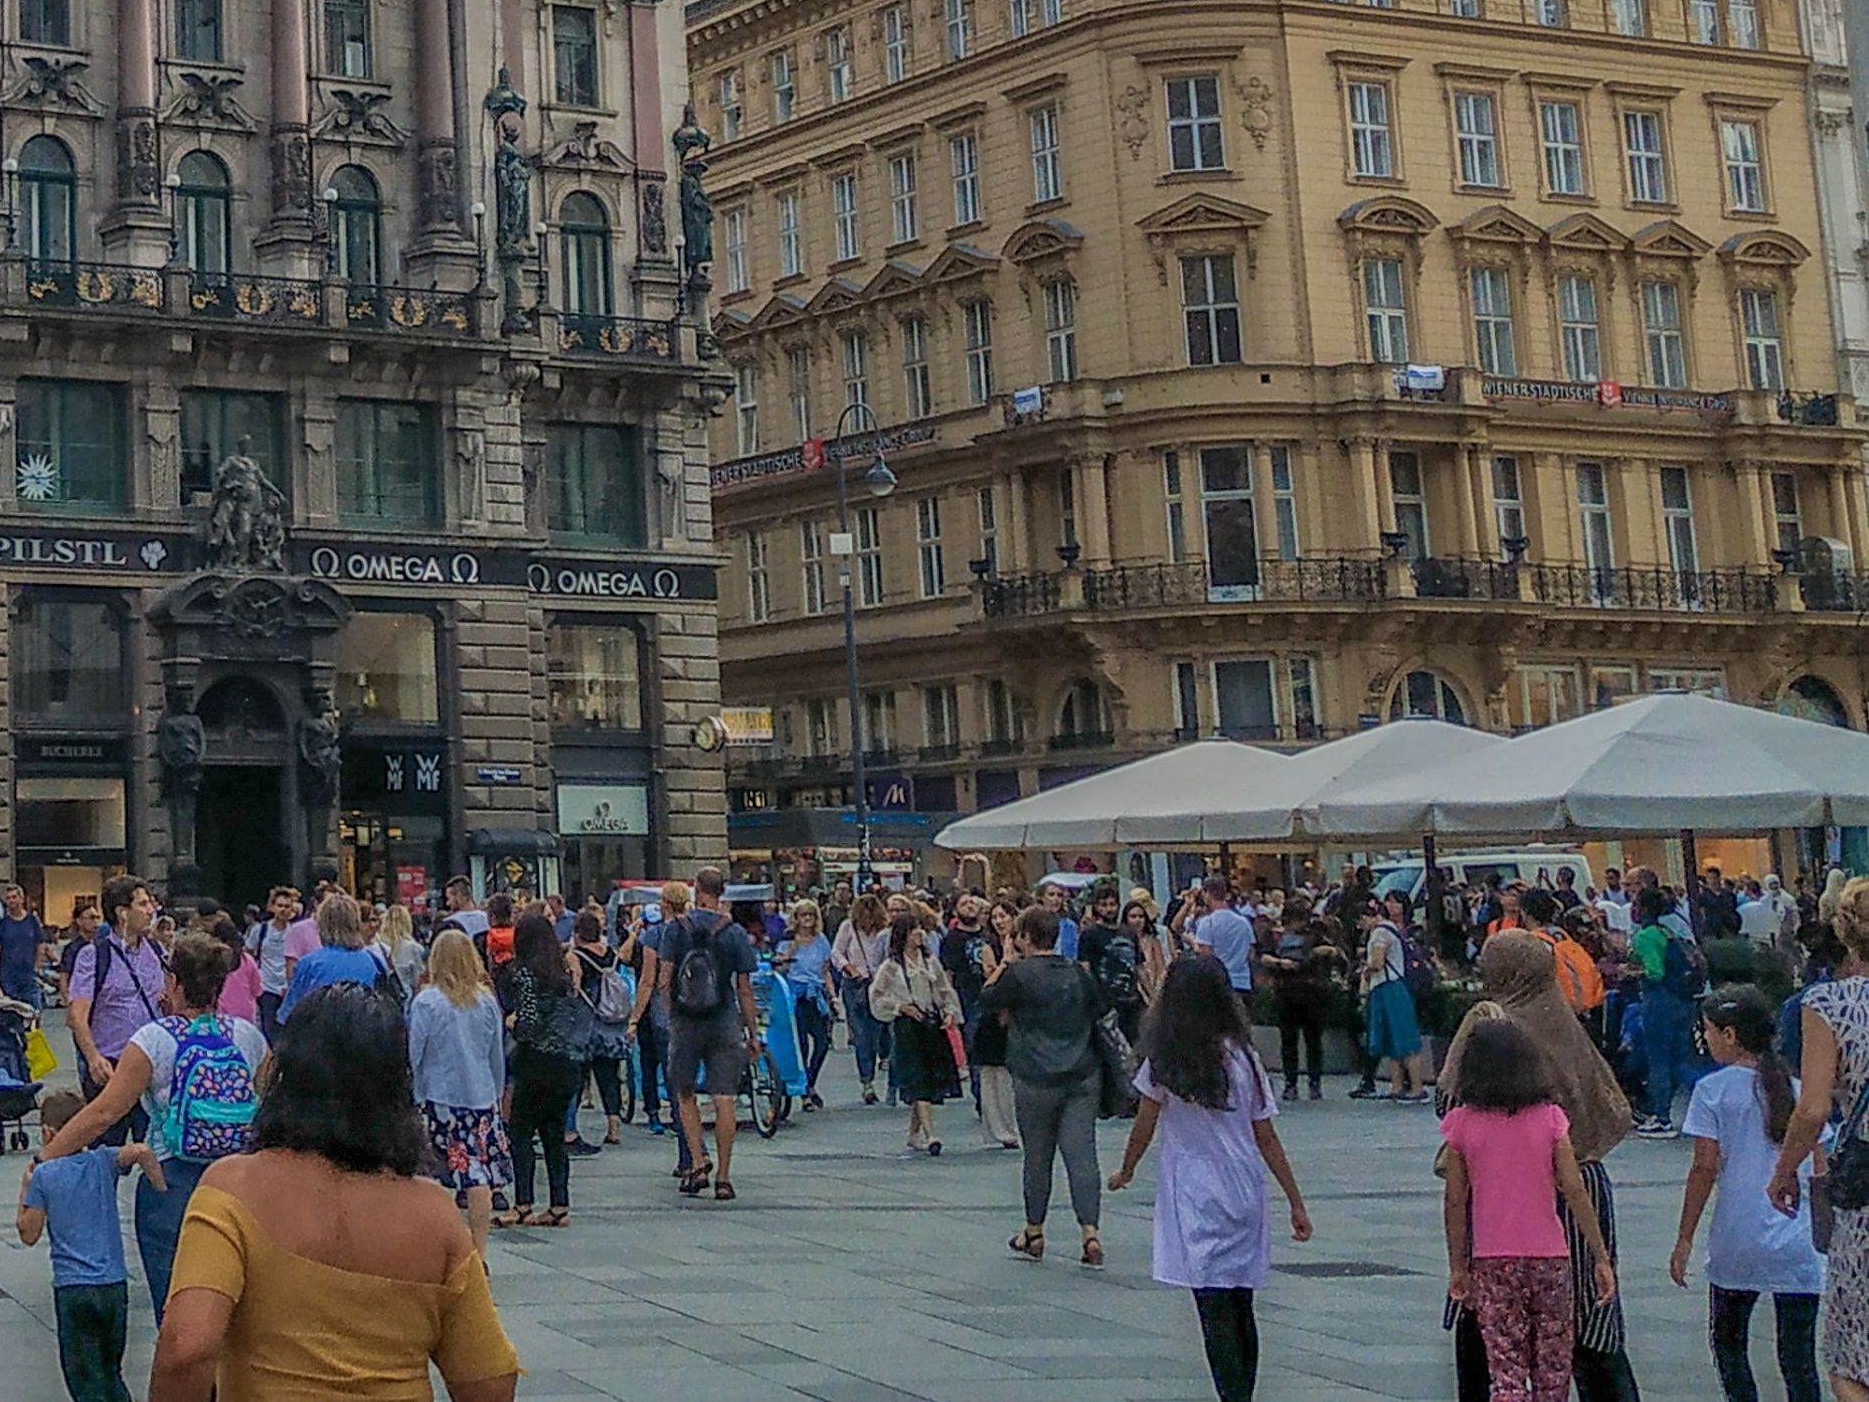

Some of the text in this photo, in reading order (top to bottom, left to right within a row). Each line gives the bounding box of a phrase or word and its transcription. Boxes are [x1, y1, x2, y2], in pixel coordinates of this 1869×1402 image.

[1483, 381, 1530, 396] WIENER
[347, 553, 444, 582] OMEGA
[557, 569, 646, 596] OMEGA
[582, 817, 629, 831] OMEGA
